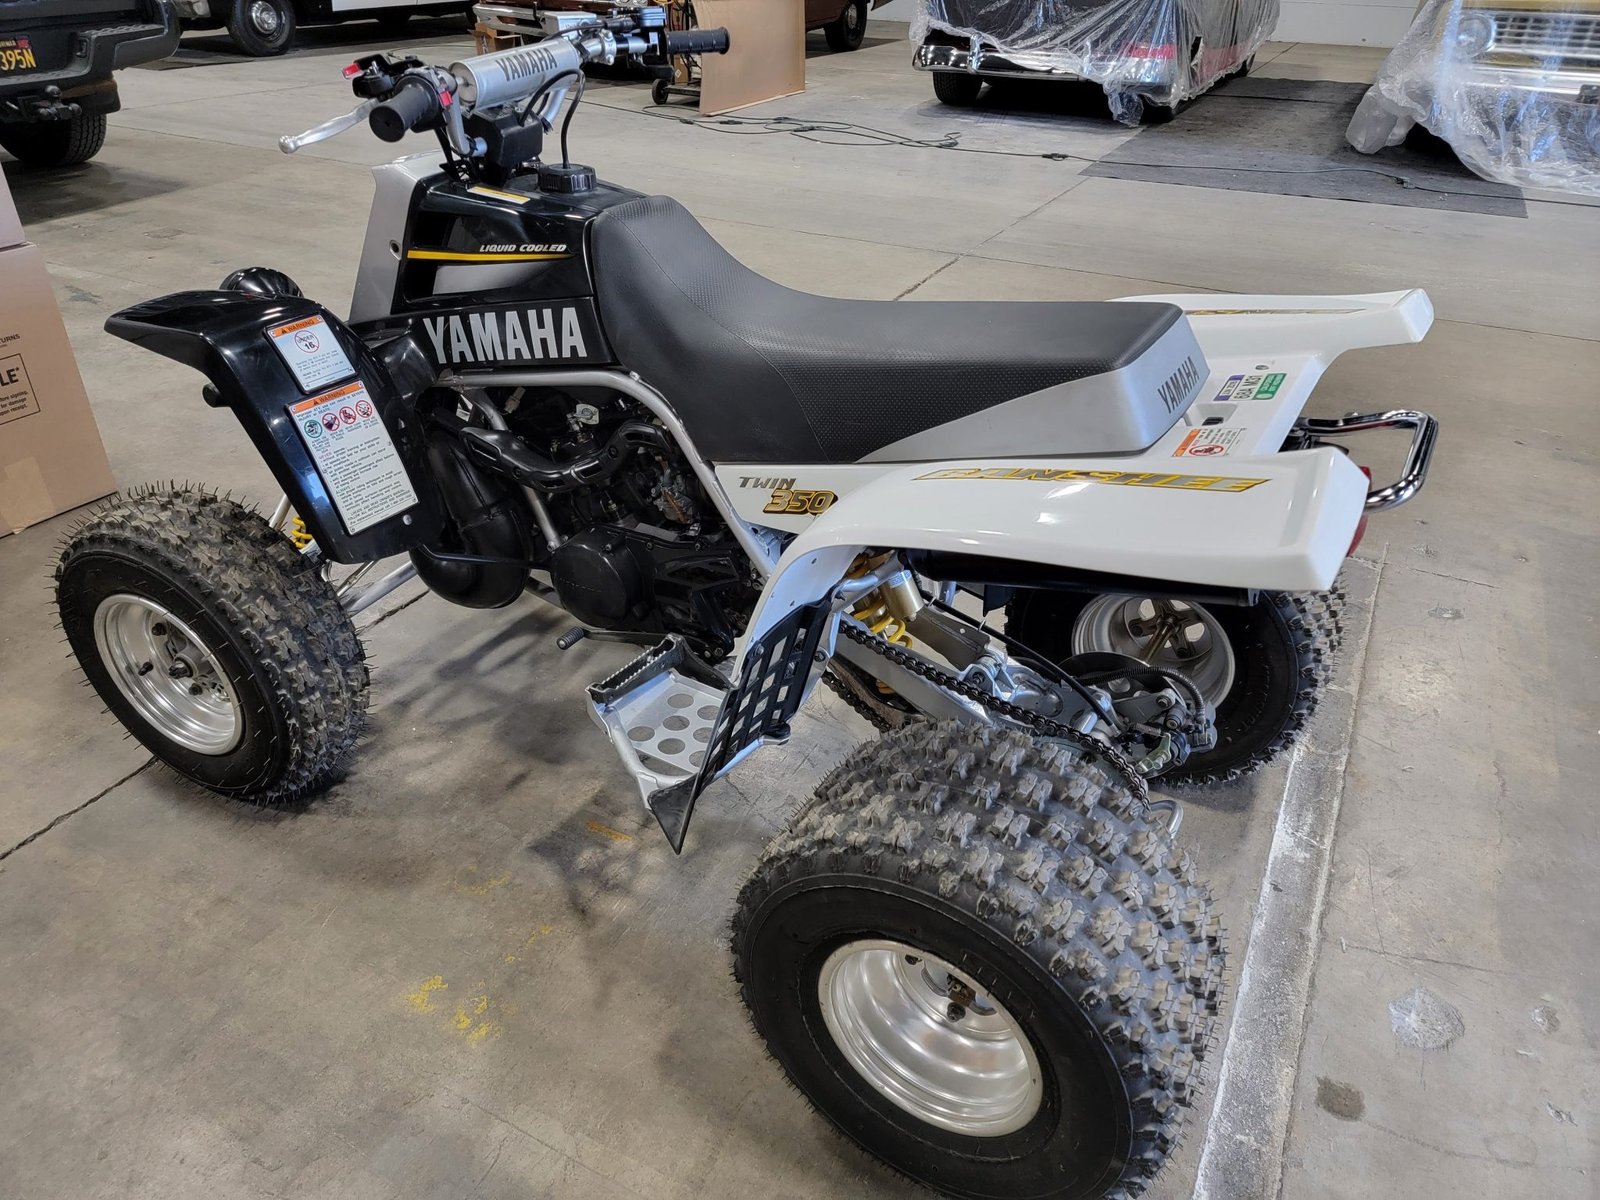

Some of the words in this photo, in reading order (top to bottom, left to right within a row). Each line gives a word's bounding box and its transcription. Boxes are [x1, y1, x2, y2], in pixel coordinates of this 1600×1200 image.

[494, 47, 558, 82] YAMAHA
[479, 244, 517, 252] LIQUID
[519, 244, 567, 252] COOLED
[288, 318, 315, 331] WARNING
[422, 307, 588, 364] YAMAHA
[304, 341, 316, 350] 16
[1157, 355, 1200, 414] YAMAHA
[319, 390, 346, 402] WARNING
[739, 476, 796, 489] TWIN
[911, 468, 1272, 493] BANSHEE
[763, 488, 839, 515] 350
